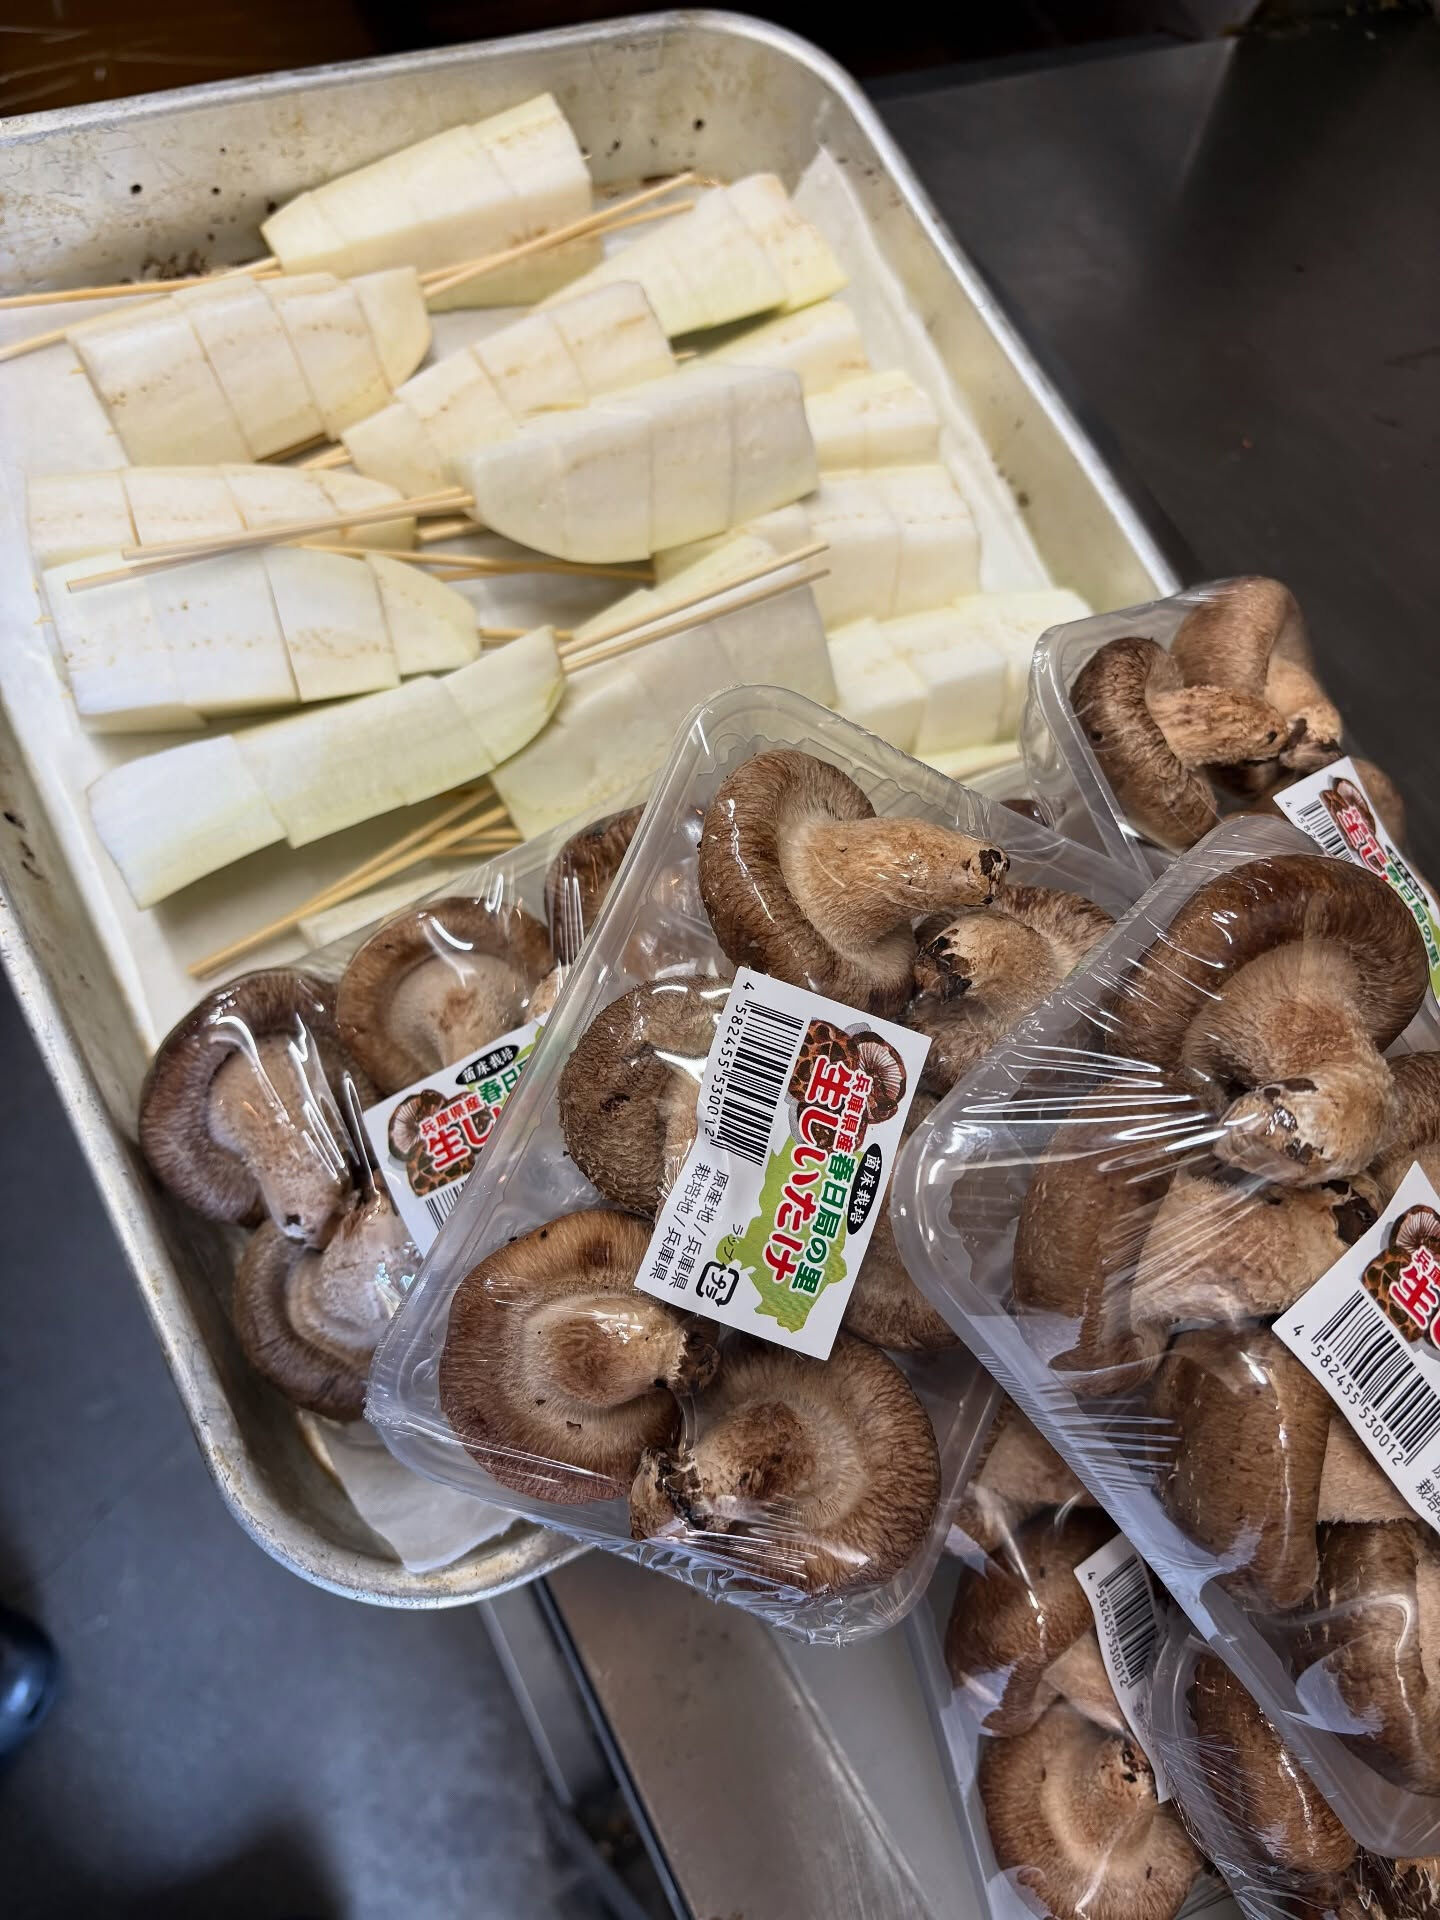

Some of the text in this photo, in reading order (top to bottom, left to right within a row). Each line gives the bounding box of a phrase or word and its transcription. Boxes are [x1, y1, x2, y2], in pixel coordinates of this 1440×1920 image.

[1338, 810, 1389, 881] 生し
[463, 1046, 515, 1083] 菌床栽培
[704, 981, 755, 1138] 4 582455 530012
[427, 1106, 502, 1169] 生し
[765, 1057, 851, 1281] 生しいたけ
[849, 1153, 882, 1225] 菌床栽培
[649, 1162, 712, 1282] 栽培地/兵庫県
[668, 1168, 730, 1291] 原産地/兵庫県
[1293, 1324, 1404, 1466] 4 582455 530012
[1087, 1571, 1129, 1687] 4 582455 530012
